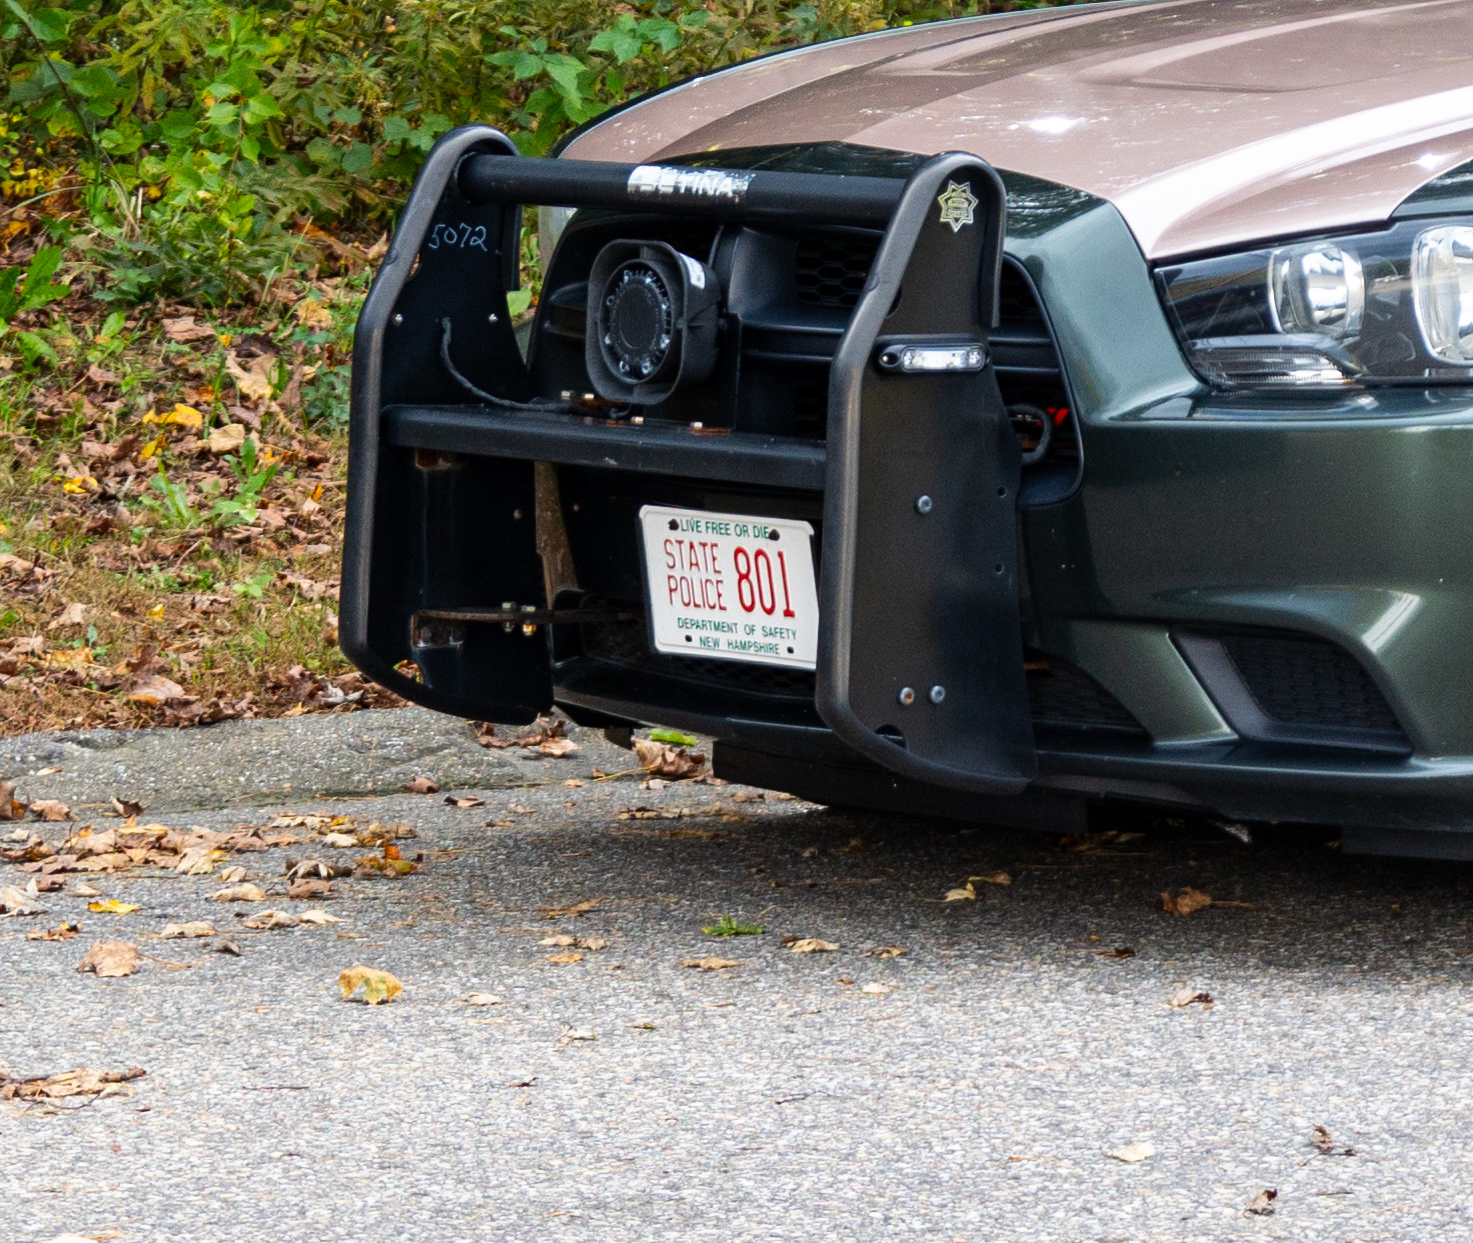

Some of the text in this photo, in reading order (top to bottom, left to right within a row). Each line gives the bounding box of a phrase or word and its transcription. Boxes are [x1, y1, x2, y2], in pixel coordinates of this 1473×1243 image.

[428, 222, 488, 252] 5072
[680, 519, 770, 540] LIVE FREE OR DIE
[663, 538, 722, 574] STATE
[667, 574, 727, 611] POLICE
[733, 546, 796, 618] 801
[677, 617, 797, 641] DEPARTMENT OF SAFETY
[699, 636, 781, 655] NEW HAMPSHIRE
